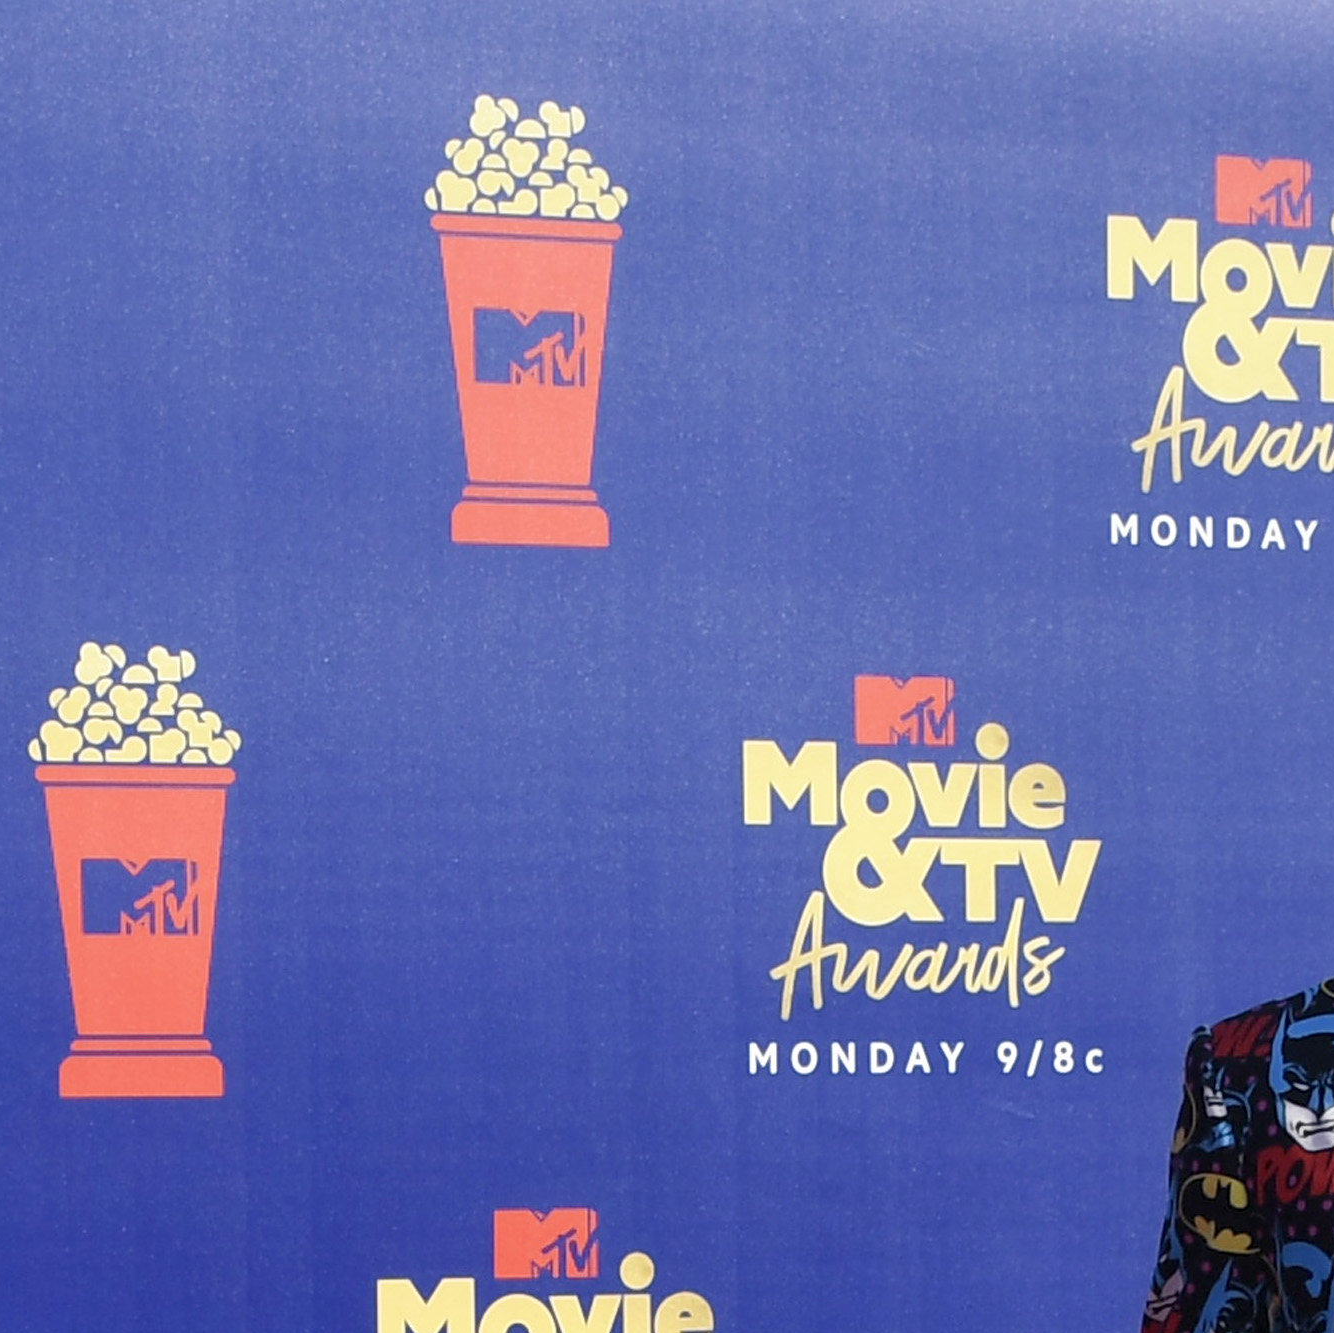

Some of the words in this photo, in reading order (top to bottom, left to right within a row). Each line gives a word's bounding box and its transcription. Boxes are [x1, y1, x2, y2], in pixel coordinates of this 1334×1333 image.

[1214, 154, 1312, 228] MTV
[473, 307, 588, 388] MTV
[1110, 513, 1319, 551] MONDAY
[854, 674, 956, 746] MTV
[743, 722, 1066, 829] Movie
[80, 857, 200, 936] MTV
[770, 890, 1066, 1021] Awards
[748, 1041, 965, 1075] MONDAY
[996, 1039, 1104, 1078] 9/8c
[493, 1207, 600, 1280] MTV
